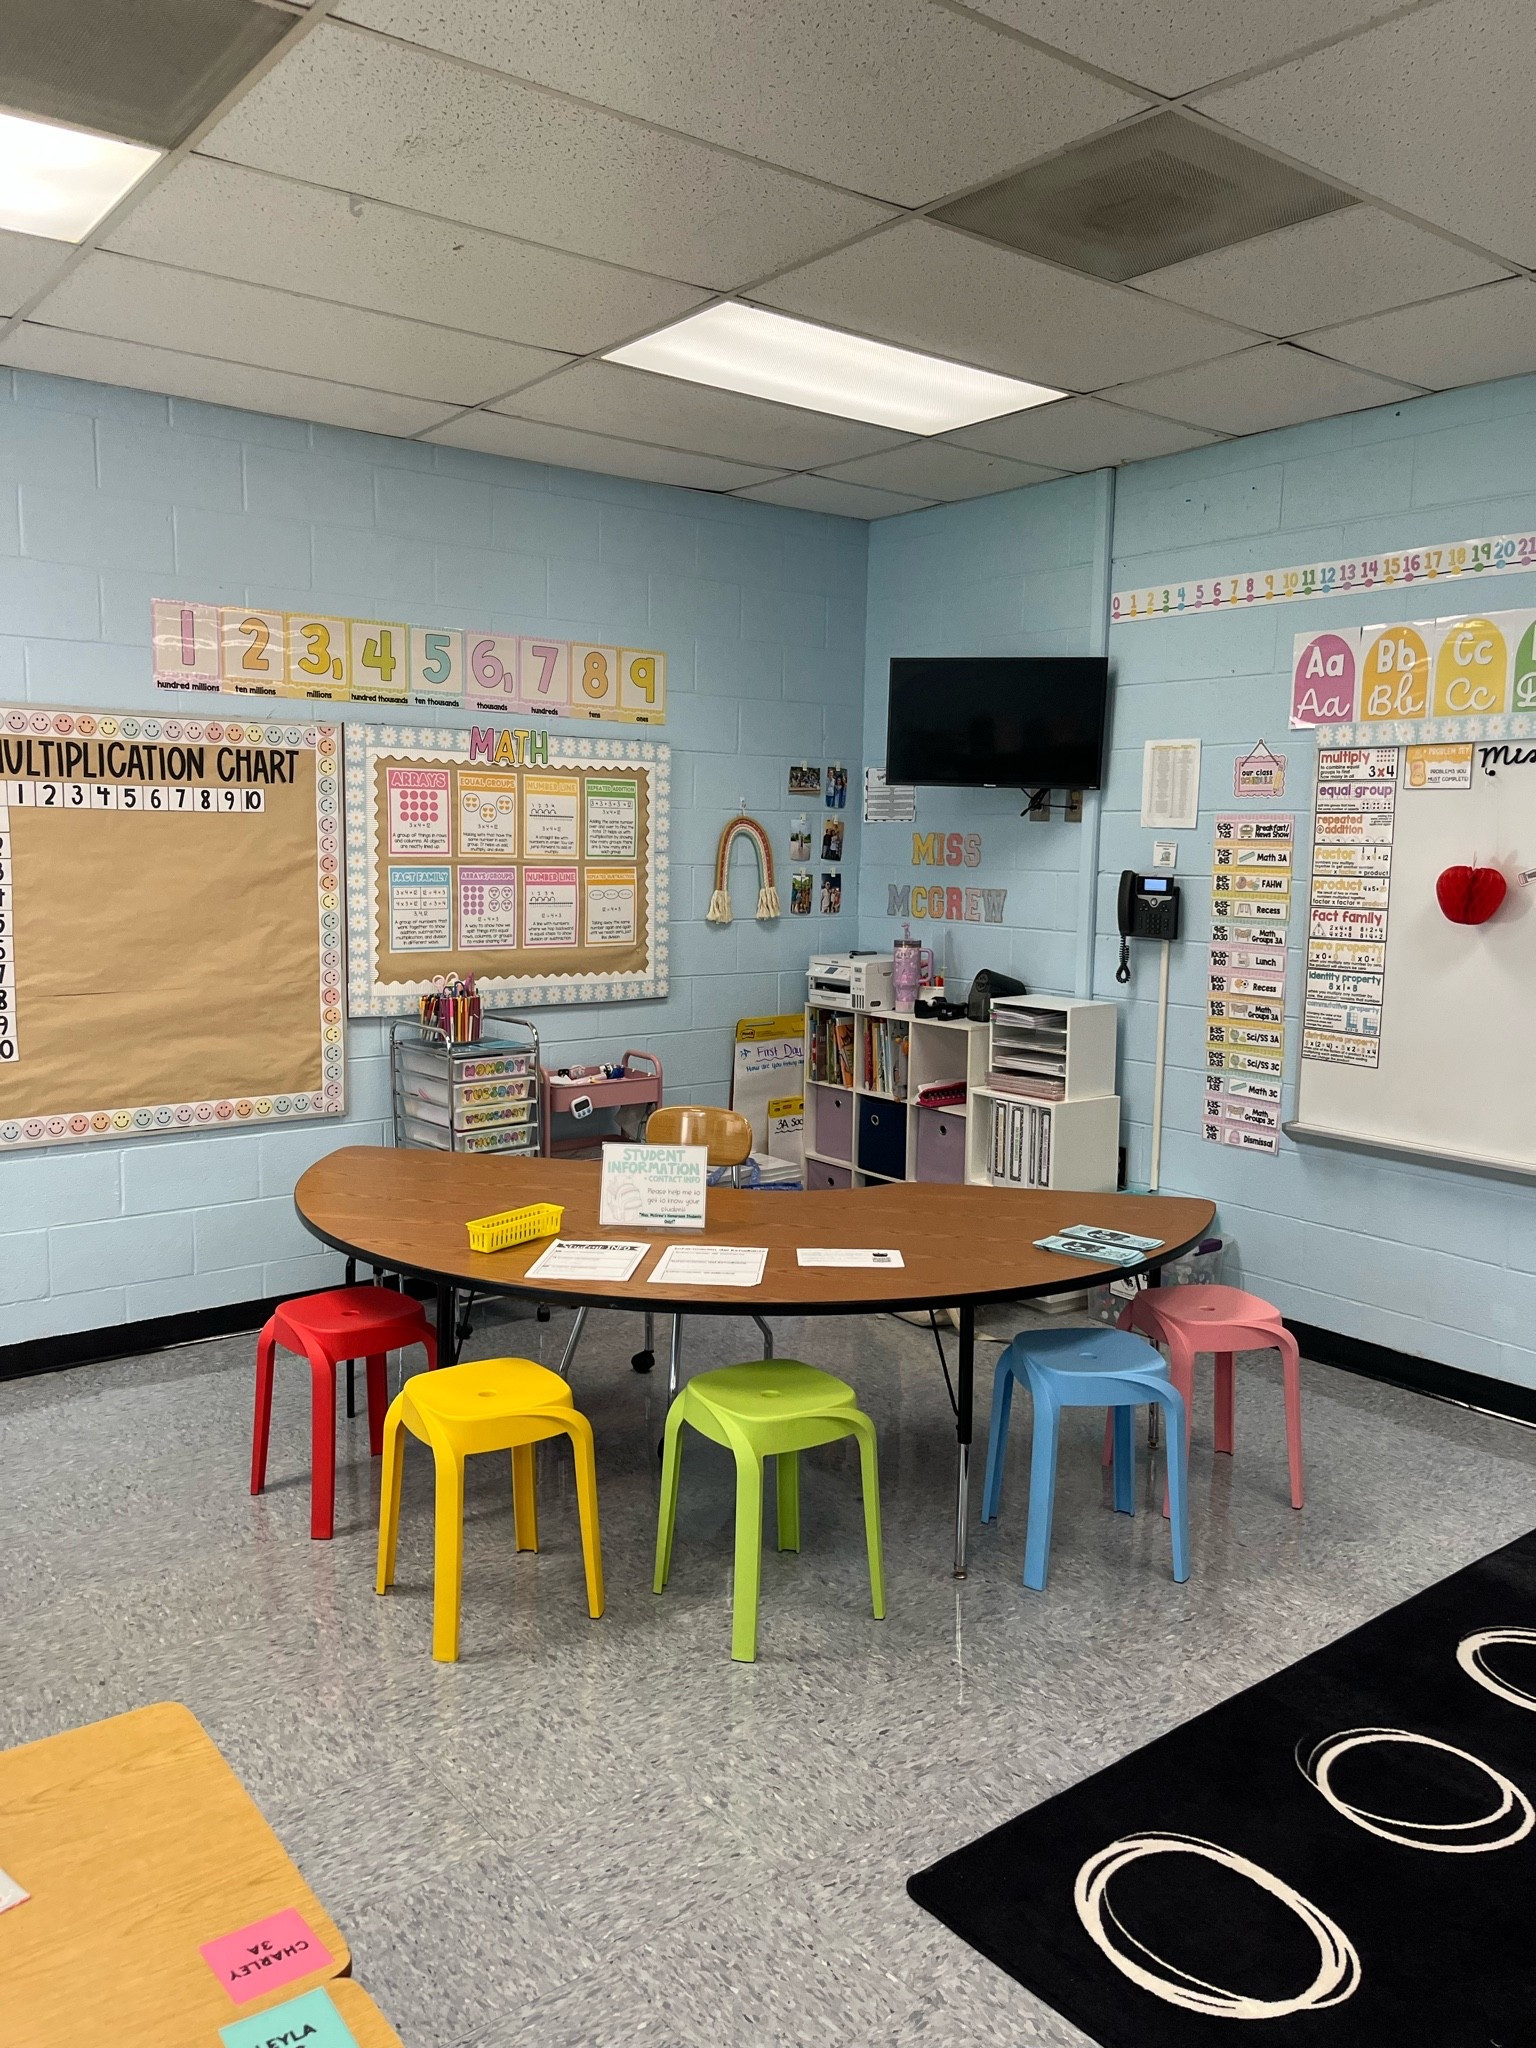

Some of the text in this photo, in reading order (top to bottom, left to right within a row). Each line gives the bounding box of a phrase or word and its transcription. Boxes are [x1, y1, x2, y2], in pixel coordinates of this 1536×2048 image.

[1113, 537, 1536, 610] 0 1 2 3 4 5 6 7 8 9 10 11 12 13 14 15 16 17 18 19 20 21
[181, 610, 195, 665] 1
[239, 617, 270, 671] 2
[1454, 632, 1493, 666] Cc
[362, 630, 396, 681] 4
[423, 634, 451, 684] 5
[1377, 639, 1416, 674] Bb
[1306, 646, 1345, 678] Aa
[532, 645, 558, 694] 7
[582, 652, 608, 698] 8
[630, 657, 655, 703] 9
[157, 681, 220, 692] hundred millions
[235, 685, 276, 695] ten millions
[306, 690, 332, 699] millions
[351, 694, 408, 704] hundred thousands
[1367, 673, 1424, 716] Bb
[1446, 677, 1496, 711] Cc
[415, 697, 459, 707] ten thousands
[476, 702, 508, 711] thousands
[1297, 688, 1350, 718] Aa
[531, 706, 558, 715] hundreds
[469, 726, 549, 764] MATH
[1321, 751, 1370, 765] multiply
[217, 747, 299, 784] CHART
[1369, 766, 1375, 777] 3
[1387, 766, 1394, 777] 4
[392, 772, 446, 787] ARRAYS
[461, 778, 515, 788] EQUAL GROUPS
[527, 782, 577, 792] NUMBER LINE
[587, 784, 612, 792] REPEATED
[1320, 784, 1392, 798] equal group
[18, 784, 261, 810] 1 2 3 4 5 6 7 8 9 10
[1318, 815, 1362, 826] repeated
[1325, 825, 1363, 834] addition
[911, 832, 982, 868] MISS
[1315, 848, 1355, 860] factor
[1257, 854, 1287, 862] Math 3A
[392, 872, 448, 882] FACT FAMILY
[526, 872, 576, 881] NUMBER LINE
[1313, 879, 1362, 891] product
[887, 884, 1008, 923] MCGREW
[1257, 906, 1280, 914] Recess
[1312, 910, 1382, 926] fact family
[1252, 936, 1273, 944] Groups
[1335, 943, 1383, 953] property
[1256, 957, 1276, 966] Lunch
[1309, 971, 1381, 985] identity property
[1253, 983, 1276, 992] Recess
[1248, 1012, 1269, 1020] Groups
[1255, 1006, 1271, 1014] Math
[1247, 1033, 1279, 1043] Sci/SS 3A
[757, 1044, 802, 1057] First Day
[465, 1060, 524, 1077] MONDAY
[1271, 1063, 1280, 1071] 3C
[464, 1083, 523, 1102] TUESDAY
[1248, 1086, 1278, 1098] Math 3C
[1252, 1109, 1268, 1117] Math
[776, 1119, 788, 1130] 3A
[1245, 1114, 1275, 1126] Groups 3C
[1244, 1135, 1273, 1148] Dismissal
[649, 1175, 700, 1184] CONTACT INFO
[668, 1188, 680, 1196] help
[246, 1940, 273, 1955] 3A
[231, 1941, 309, 1981] CHARLEY
[255, 2024, 317, 2048] EYLA
